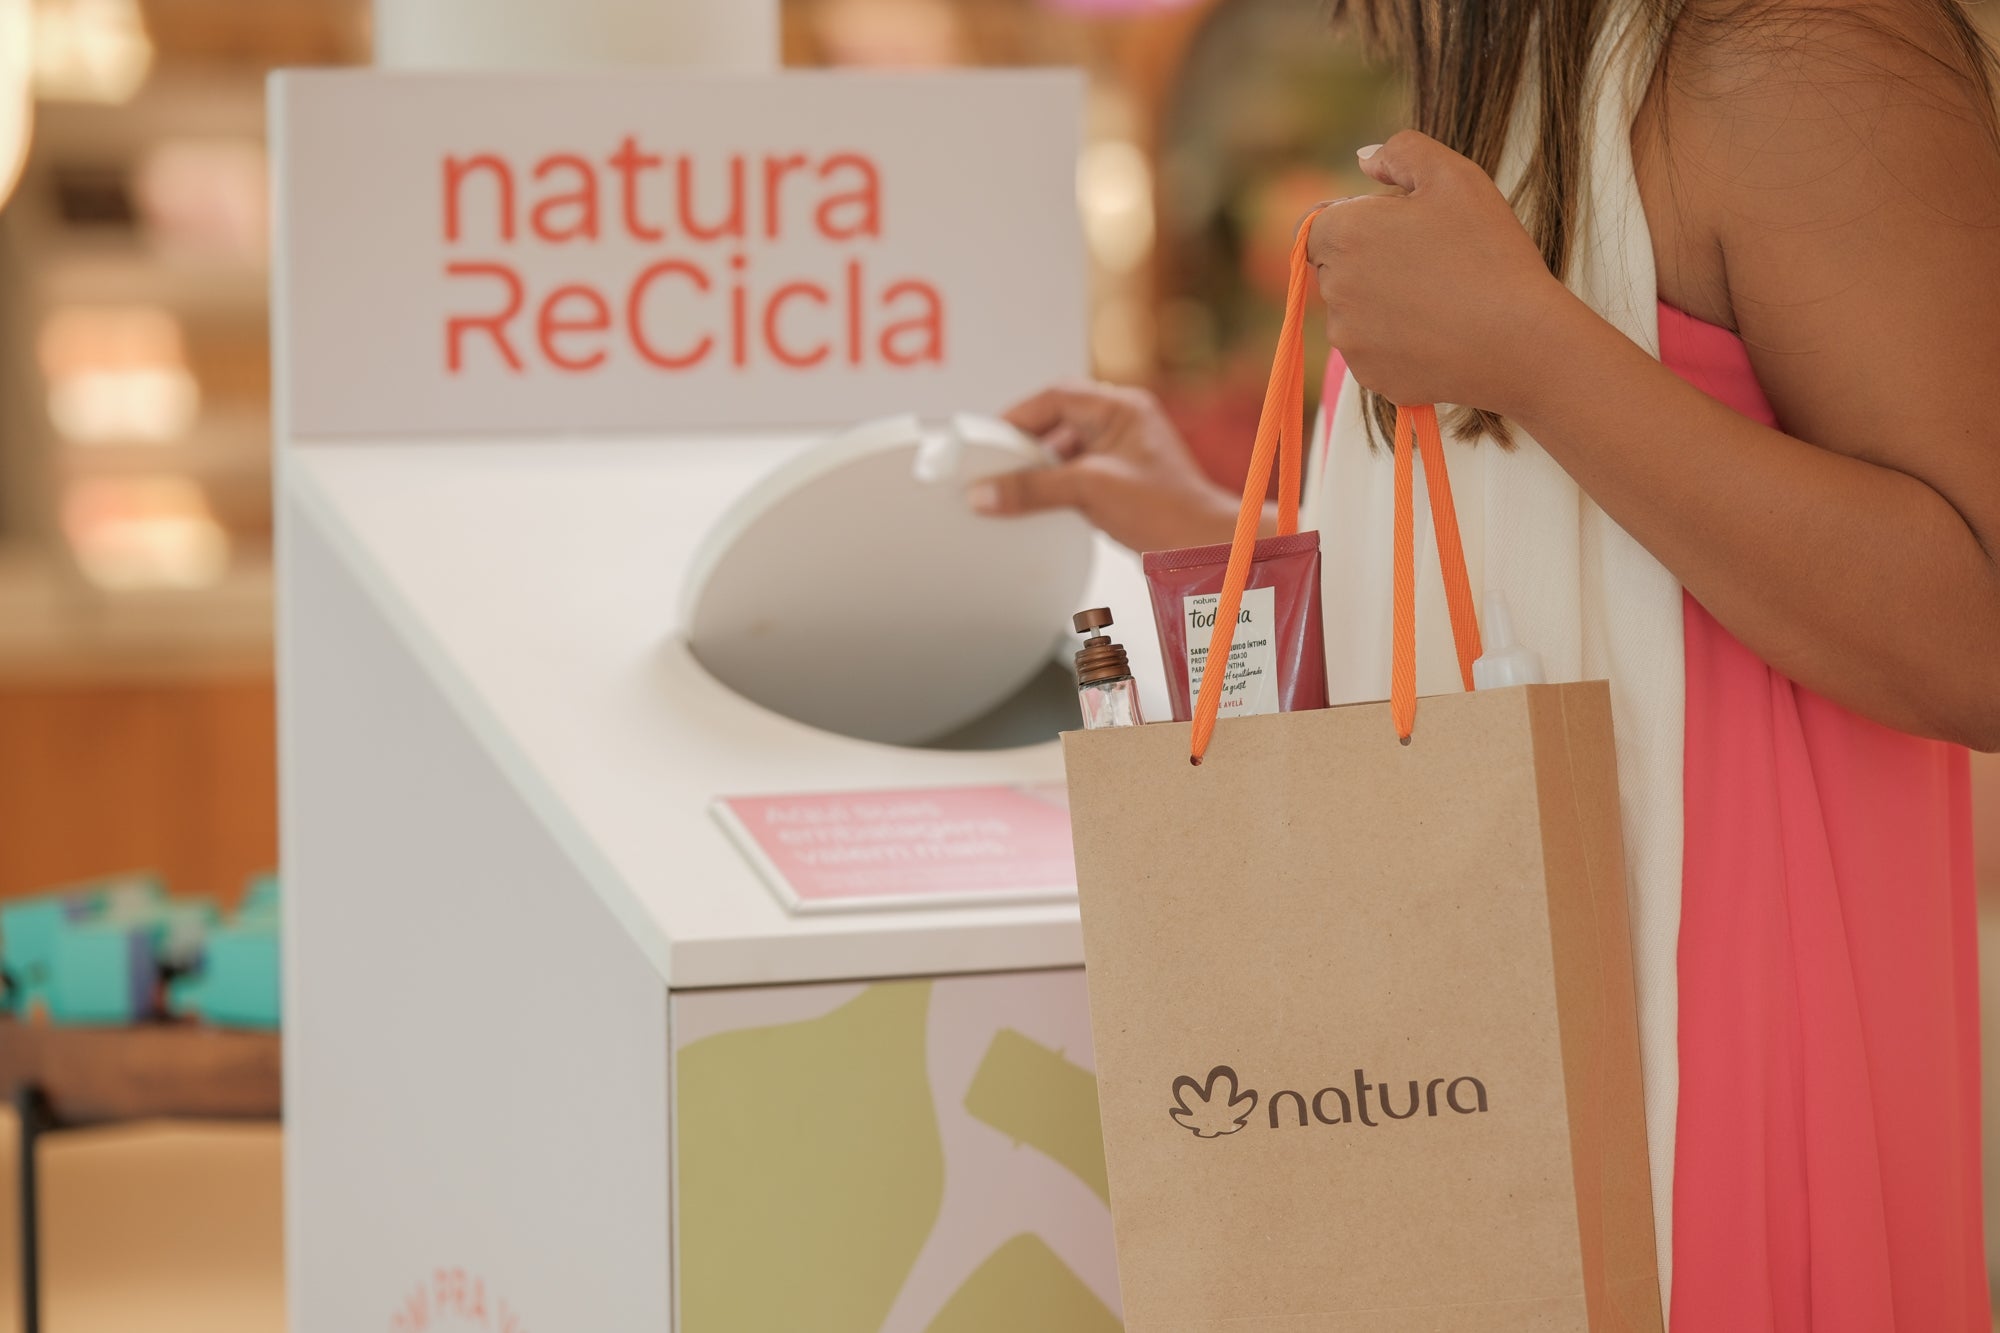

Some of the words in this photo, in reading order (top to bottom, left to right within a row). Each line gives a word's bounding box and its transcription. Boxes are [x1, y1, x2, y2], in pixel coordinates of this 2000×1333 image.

[441, 134, 881, 243] natura
[444, 254, 945, 374] ReCicla
[1193, 597, 1217, 606] natura
[1247, 639, 1267, 649] ÍNTIMO
[1223, 698, 1244, 709] AVELÃ
[1267, 1069, 1489, 1129] natura
